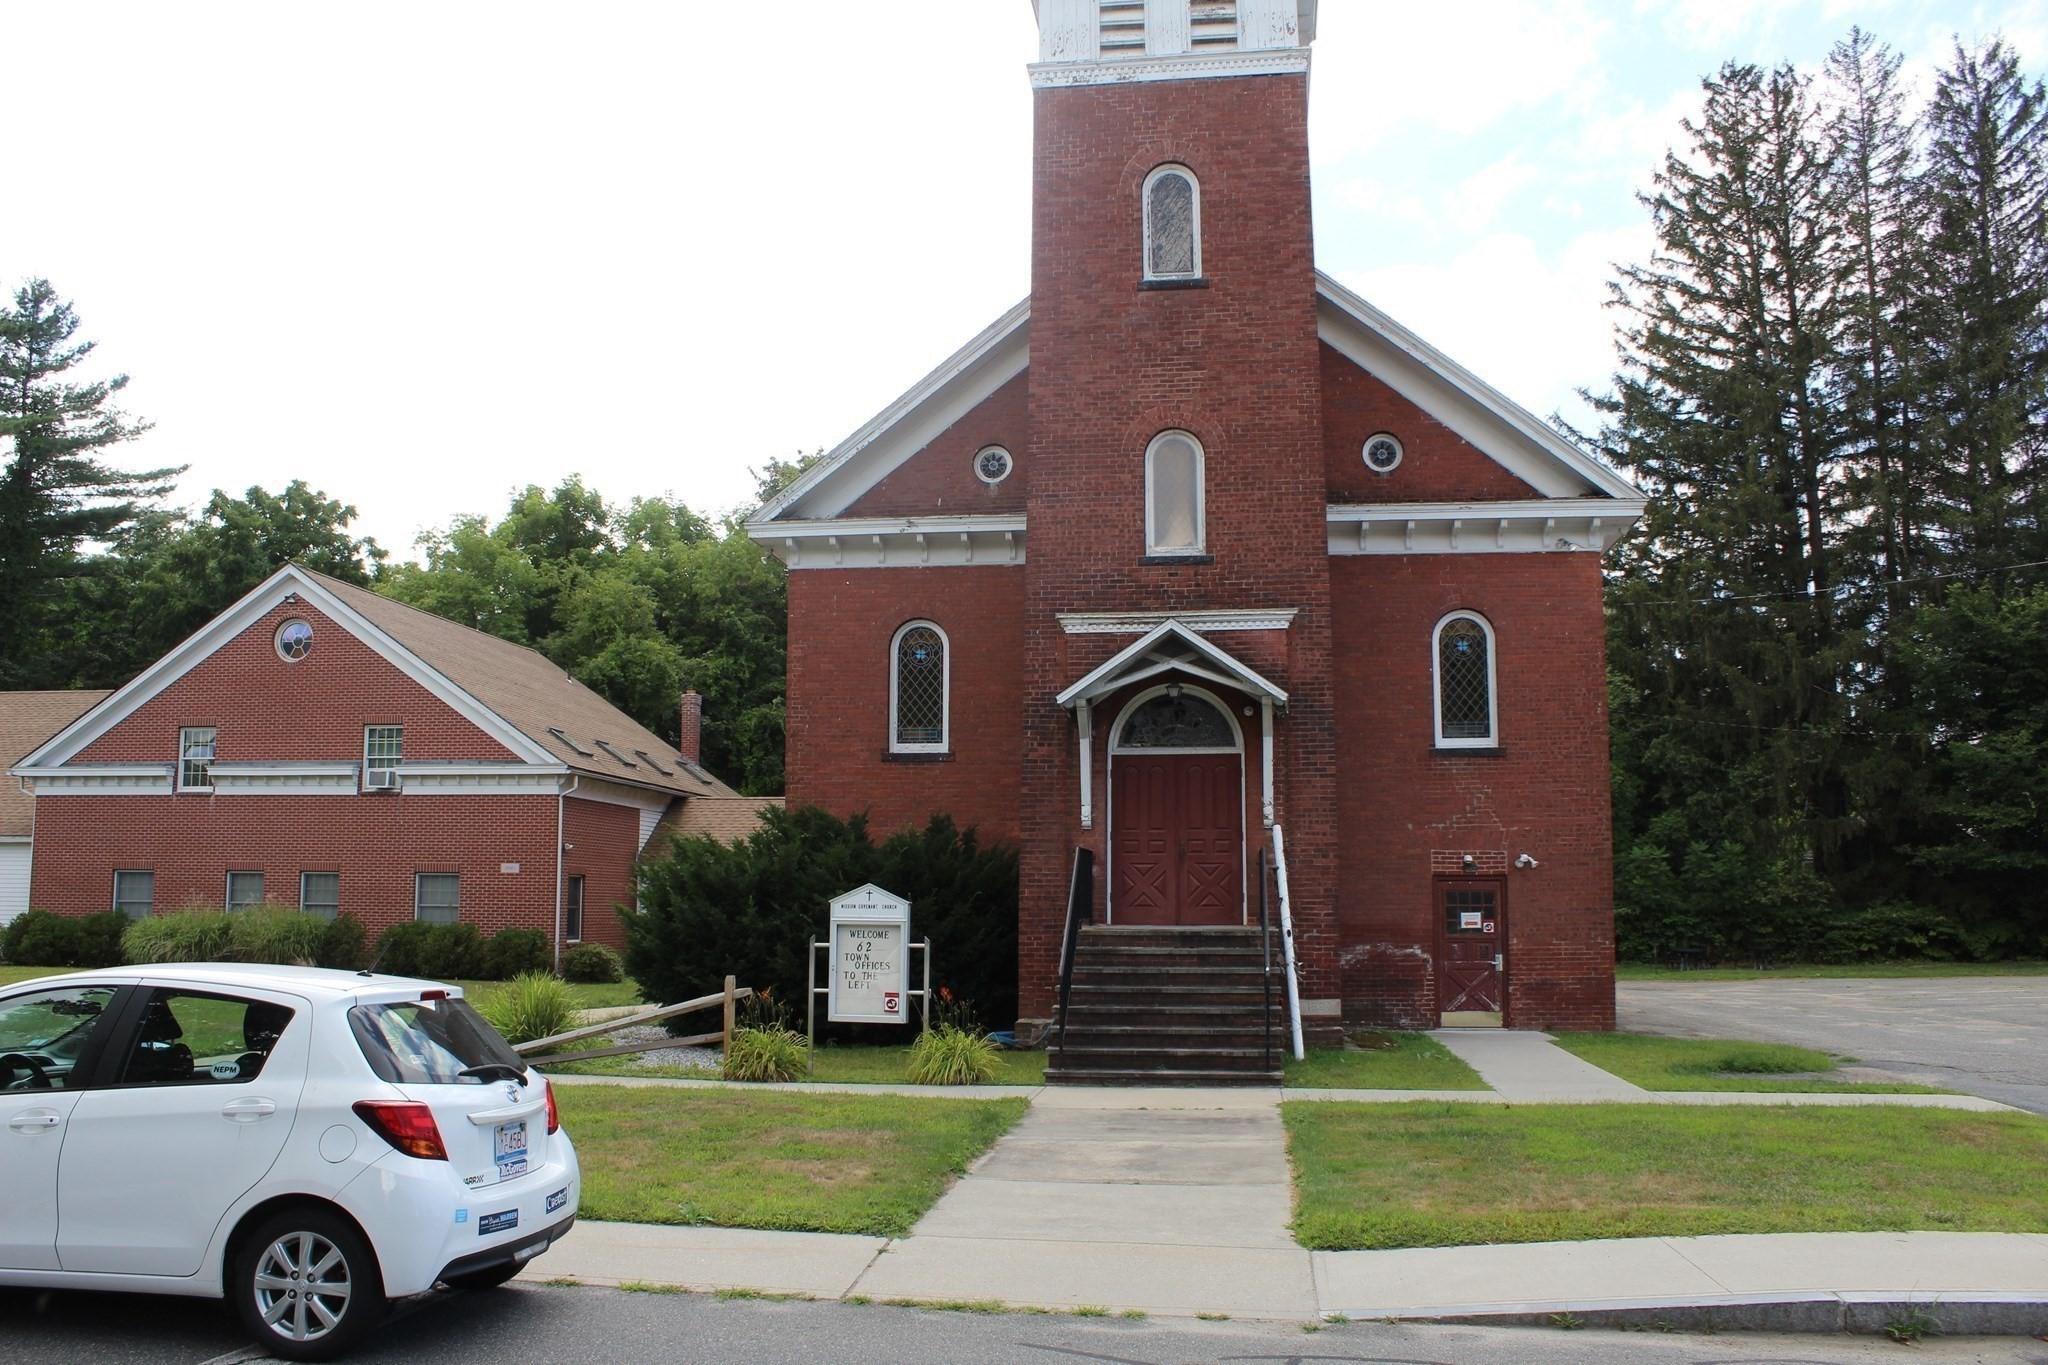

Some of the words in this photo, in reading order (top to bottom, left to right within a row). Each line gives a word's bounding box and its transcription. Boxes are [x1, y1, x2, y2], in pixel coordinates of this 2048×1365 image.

[849, 930, 890, 939] WELCOME
[844, 952, 870, 961] TOWN
[854, 961, 891, 970] OFFICES
[843, 971, 856, 980] TO
[861, 971, 878, 980] THE
[848, 980, 872, 989] LEFT
[213, 1065, 237, 1074] NEPM
